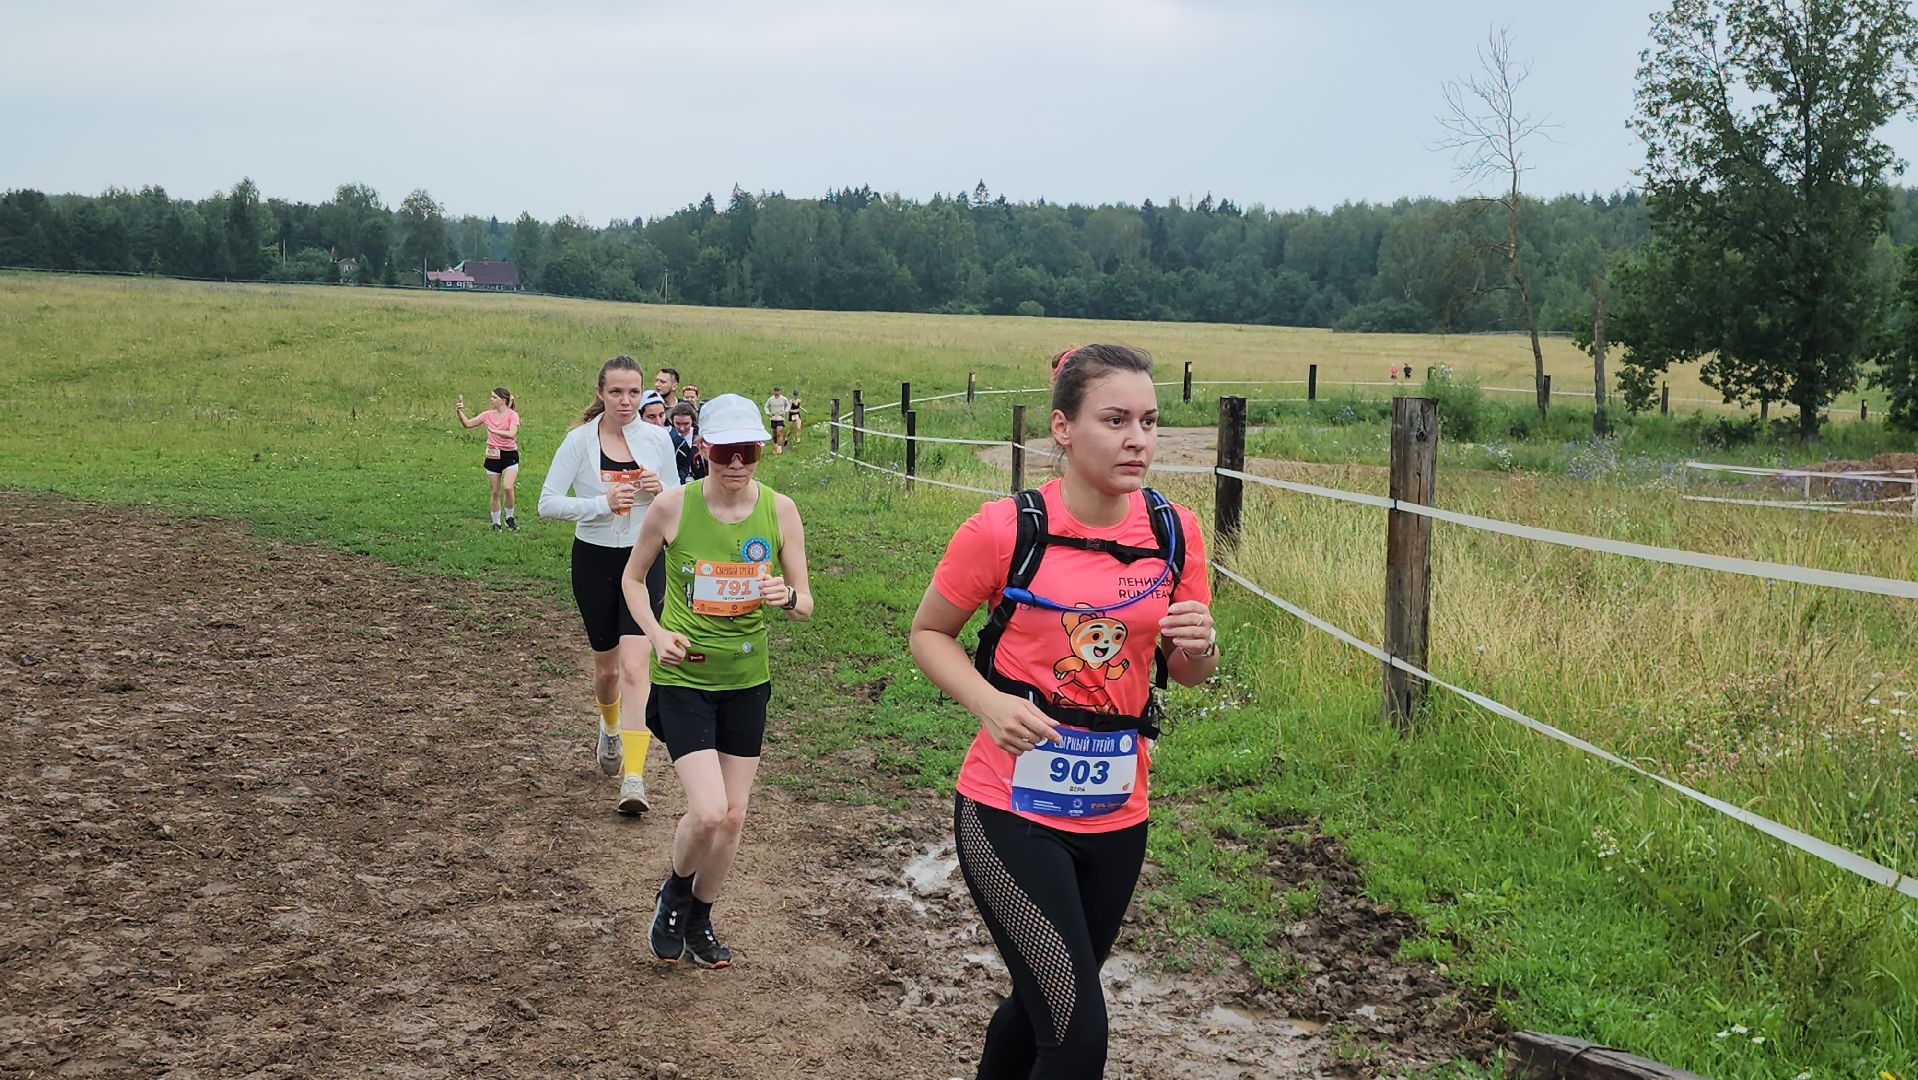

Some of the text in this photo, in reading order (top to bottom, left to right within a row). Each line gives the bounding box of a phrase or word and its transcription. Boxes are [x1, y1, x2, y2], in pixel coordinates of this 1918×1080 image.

[715, 579, 752, 596] 791
[1092, 737, 1115, 753] ТРЕЙЛ
[1049, 757, 1110, 785] 903
